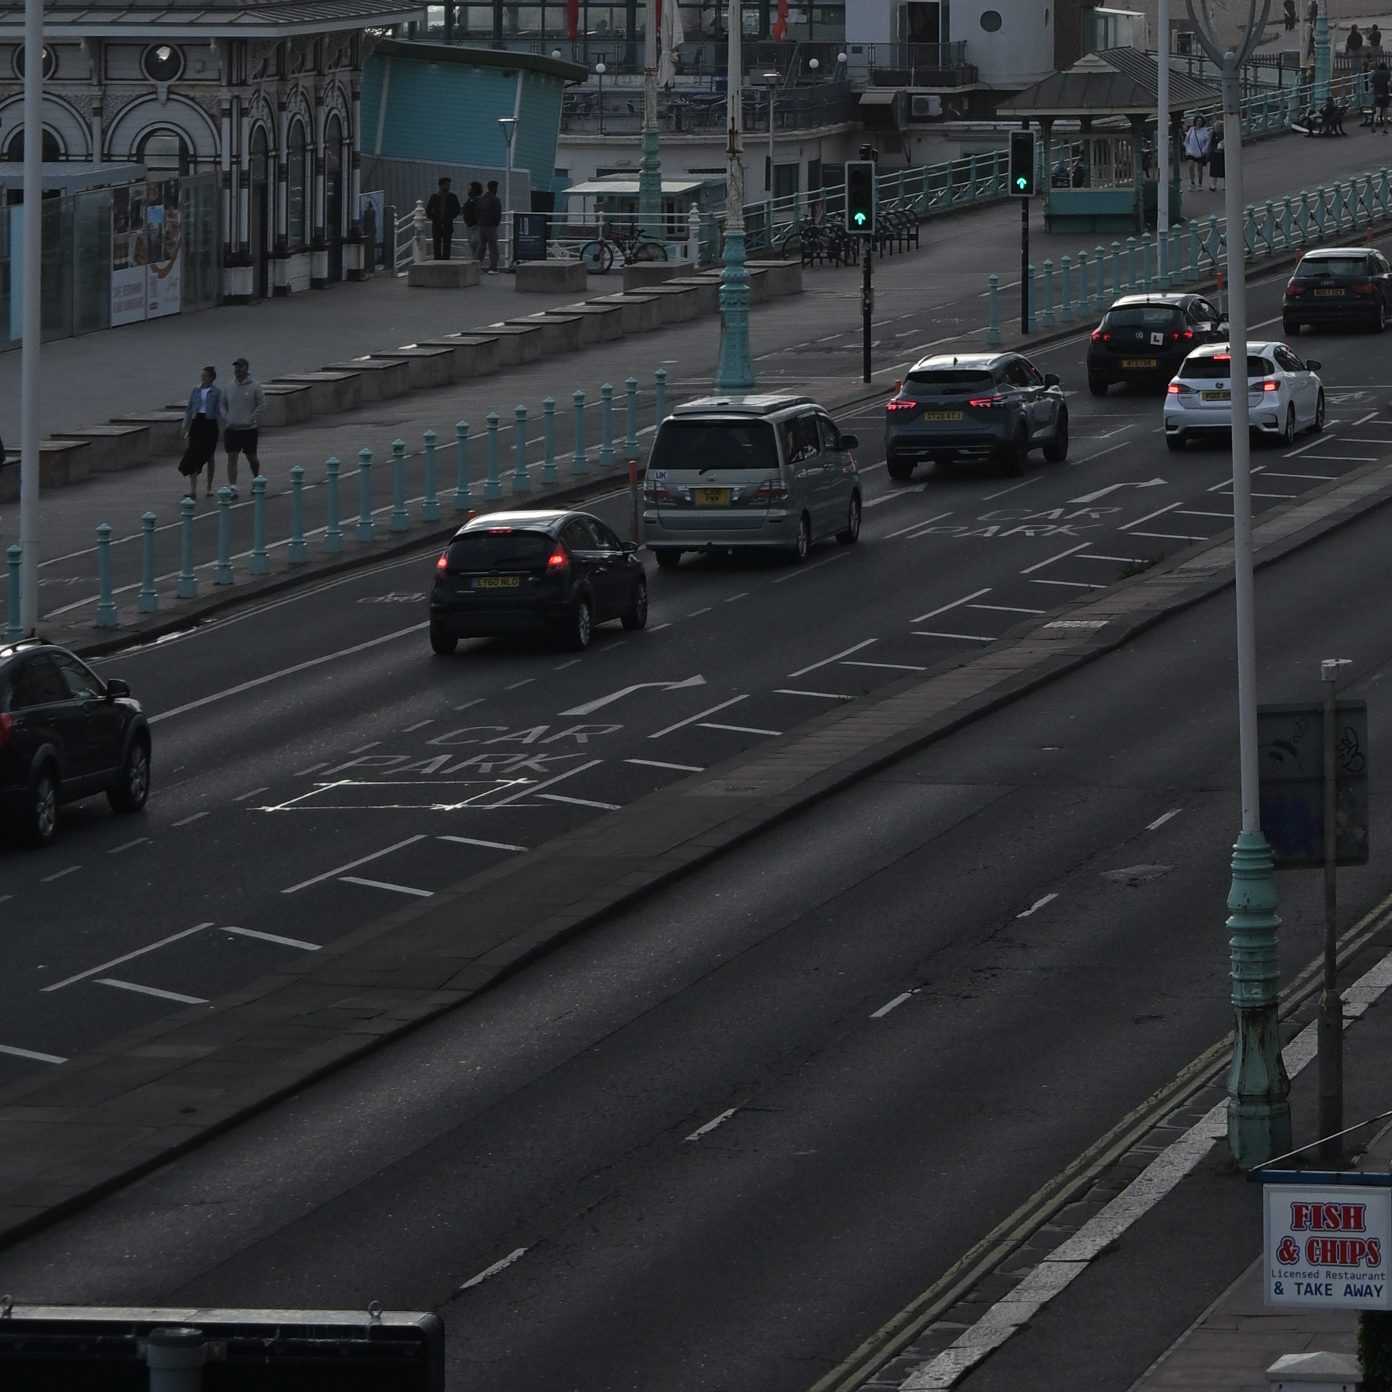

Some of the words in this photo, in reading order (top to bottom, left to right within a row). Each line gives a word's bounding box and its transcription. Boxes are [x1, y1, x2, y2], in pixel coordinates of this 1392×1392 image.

[656, 471, 667, 479] UK
[977, 507, 1123, 521] CAR
[906, 524, 1103, 538] PARK
[426, 724, 624, 745] CAR
[319, 752, 588, 776] PARK
[1291, 1202, 1366, 1232] FISH
[1277, 1236, 1300, 1265] &
[1306, 1236, 1381, 1267] CHIPS
[1271, 1269, 1320, 1279] Licensed
[1326, 1270, 1386, 1281] Restaurant
[1273, 1281, 1284, 1295] &
[1294, 1282, 1333, 1297] TAKE
[1343, 1284, 1384, 1298] AWAY
